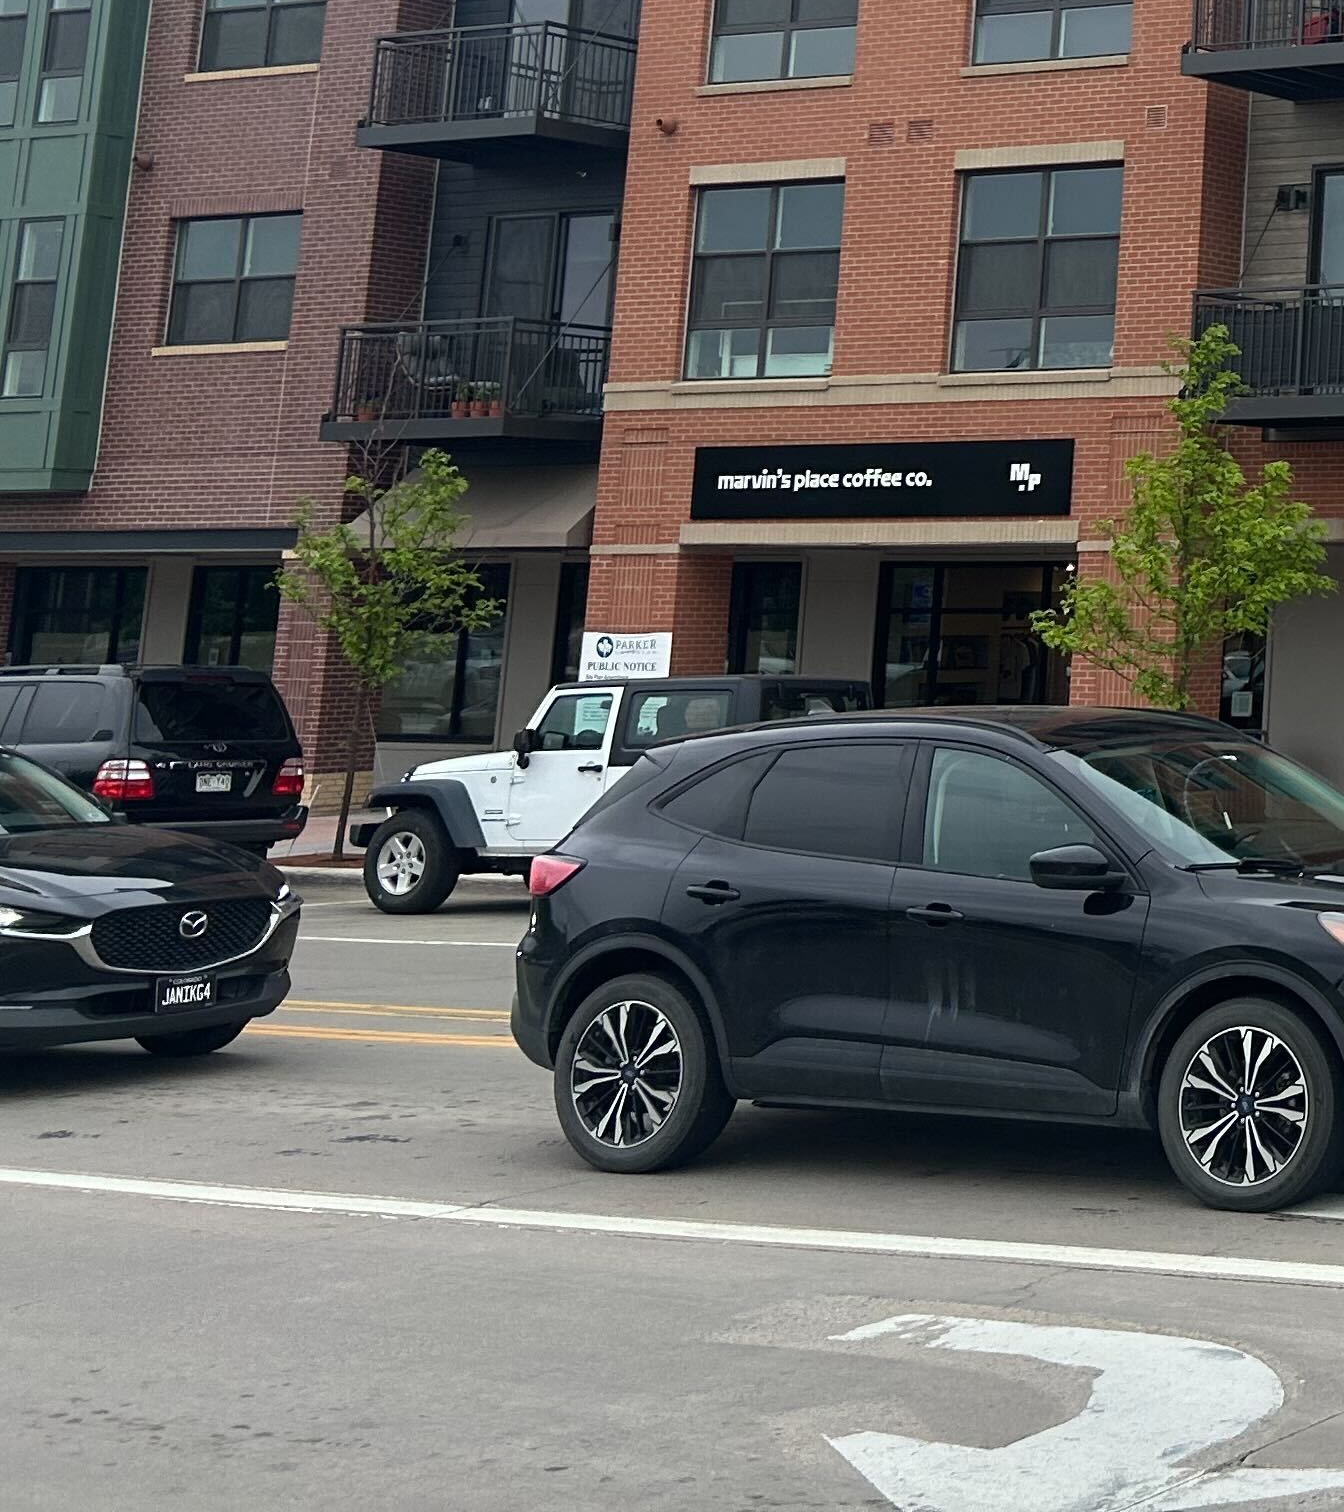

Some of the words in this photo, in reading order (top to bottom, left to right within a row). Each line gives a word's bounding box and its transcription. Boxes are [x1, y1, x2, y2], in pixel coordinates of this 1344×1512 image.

[717, 468, 791, 490] marvin's
[793, 469, 839, 492] place
[842, 468, 902, 489] coffee
[905, 471, 933, 487] co.
[615, 639, 657, 650] PARKER
[587, 662, 620, 671] PUBLIC
[623, 662, 657, 672] NOTICE
[162, 982, 211, 1005] JANIKG4
